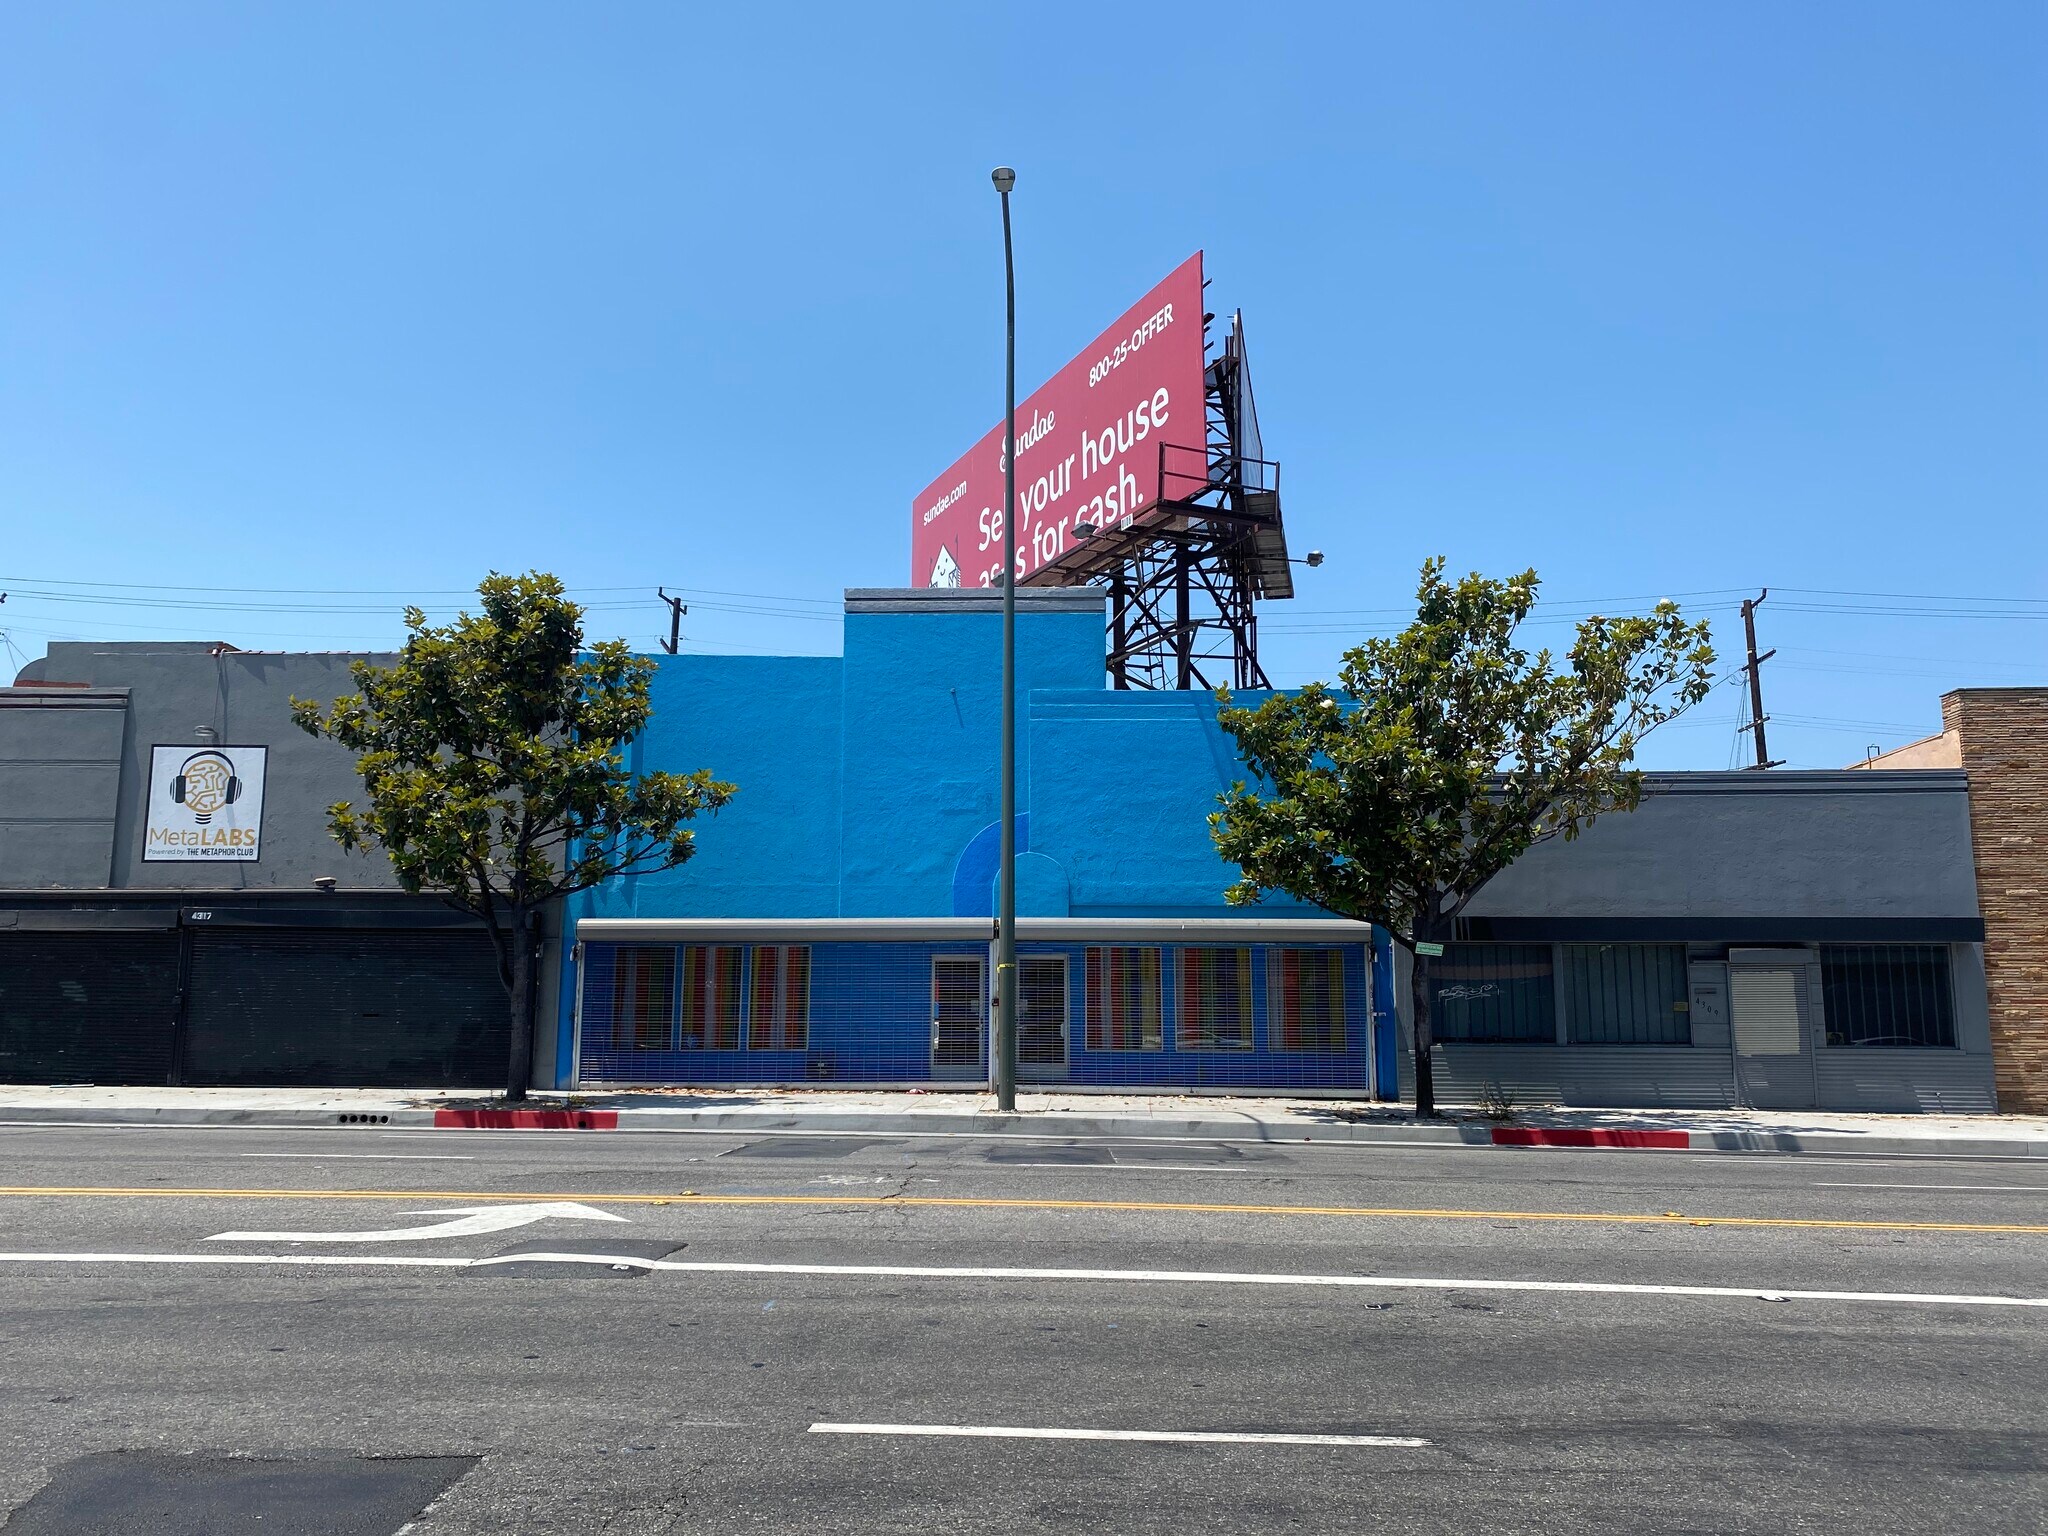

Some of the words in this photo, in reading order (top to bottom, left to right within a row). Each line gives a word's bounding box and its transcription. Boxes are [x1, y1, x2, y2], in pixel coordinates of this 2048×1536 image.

[1089, 303, 1174, 388] 800-25-OFFER
[978, 492, 1006, 551] Se
[1020, 452, 1075, 532] your
[1082, 387, 1170, 480] house
[923, 480, 967, 527] sundae.com
[1032, 516, 1069, 569] for
[1075, 463, 1144, 541] cash.
[149, 827, 256, 847] MetaLABS
[176, 848, 185, 857] by
[187, 848, 199, 856] THE
[200, 848, 235, 856] METAPHOR
[236, 848, 254, 856] CLUB
[191, 911, 212, 920] 4317
[1695, 997, 1719, 1016] 4309
